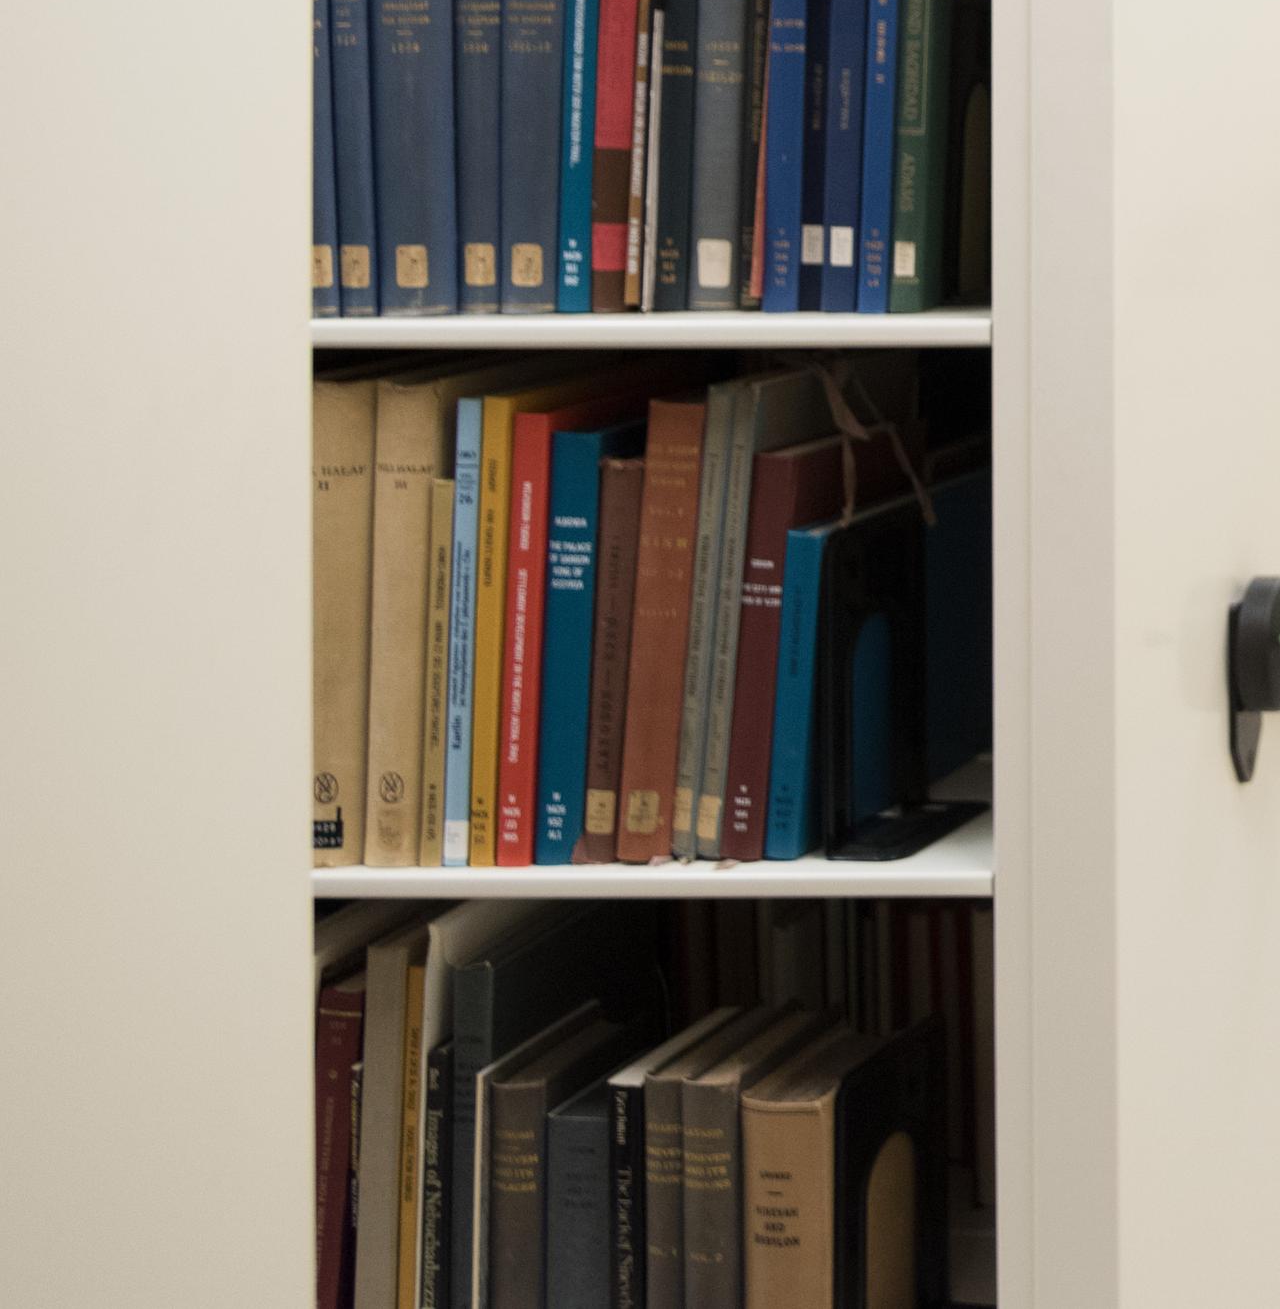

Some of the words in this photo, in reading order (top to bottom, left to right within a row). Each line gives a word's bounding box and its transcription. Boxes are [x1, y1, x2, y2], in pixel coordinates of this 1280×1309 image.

[903, 39, 921, 120] BAGHDAD
[899, 152, 915, 213] ADAMS
[426, 1107, 443, 1166] Images
[426, 1169, 442, 1188] of
